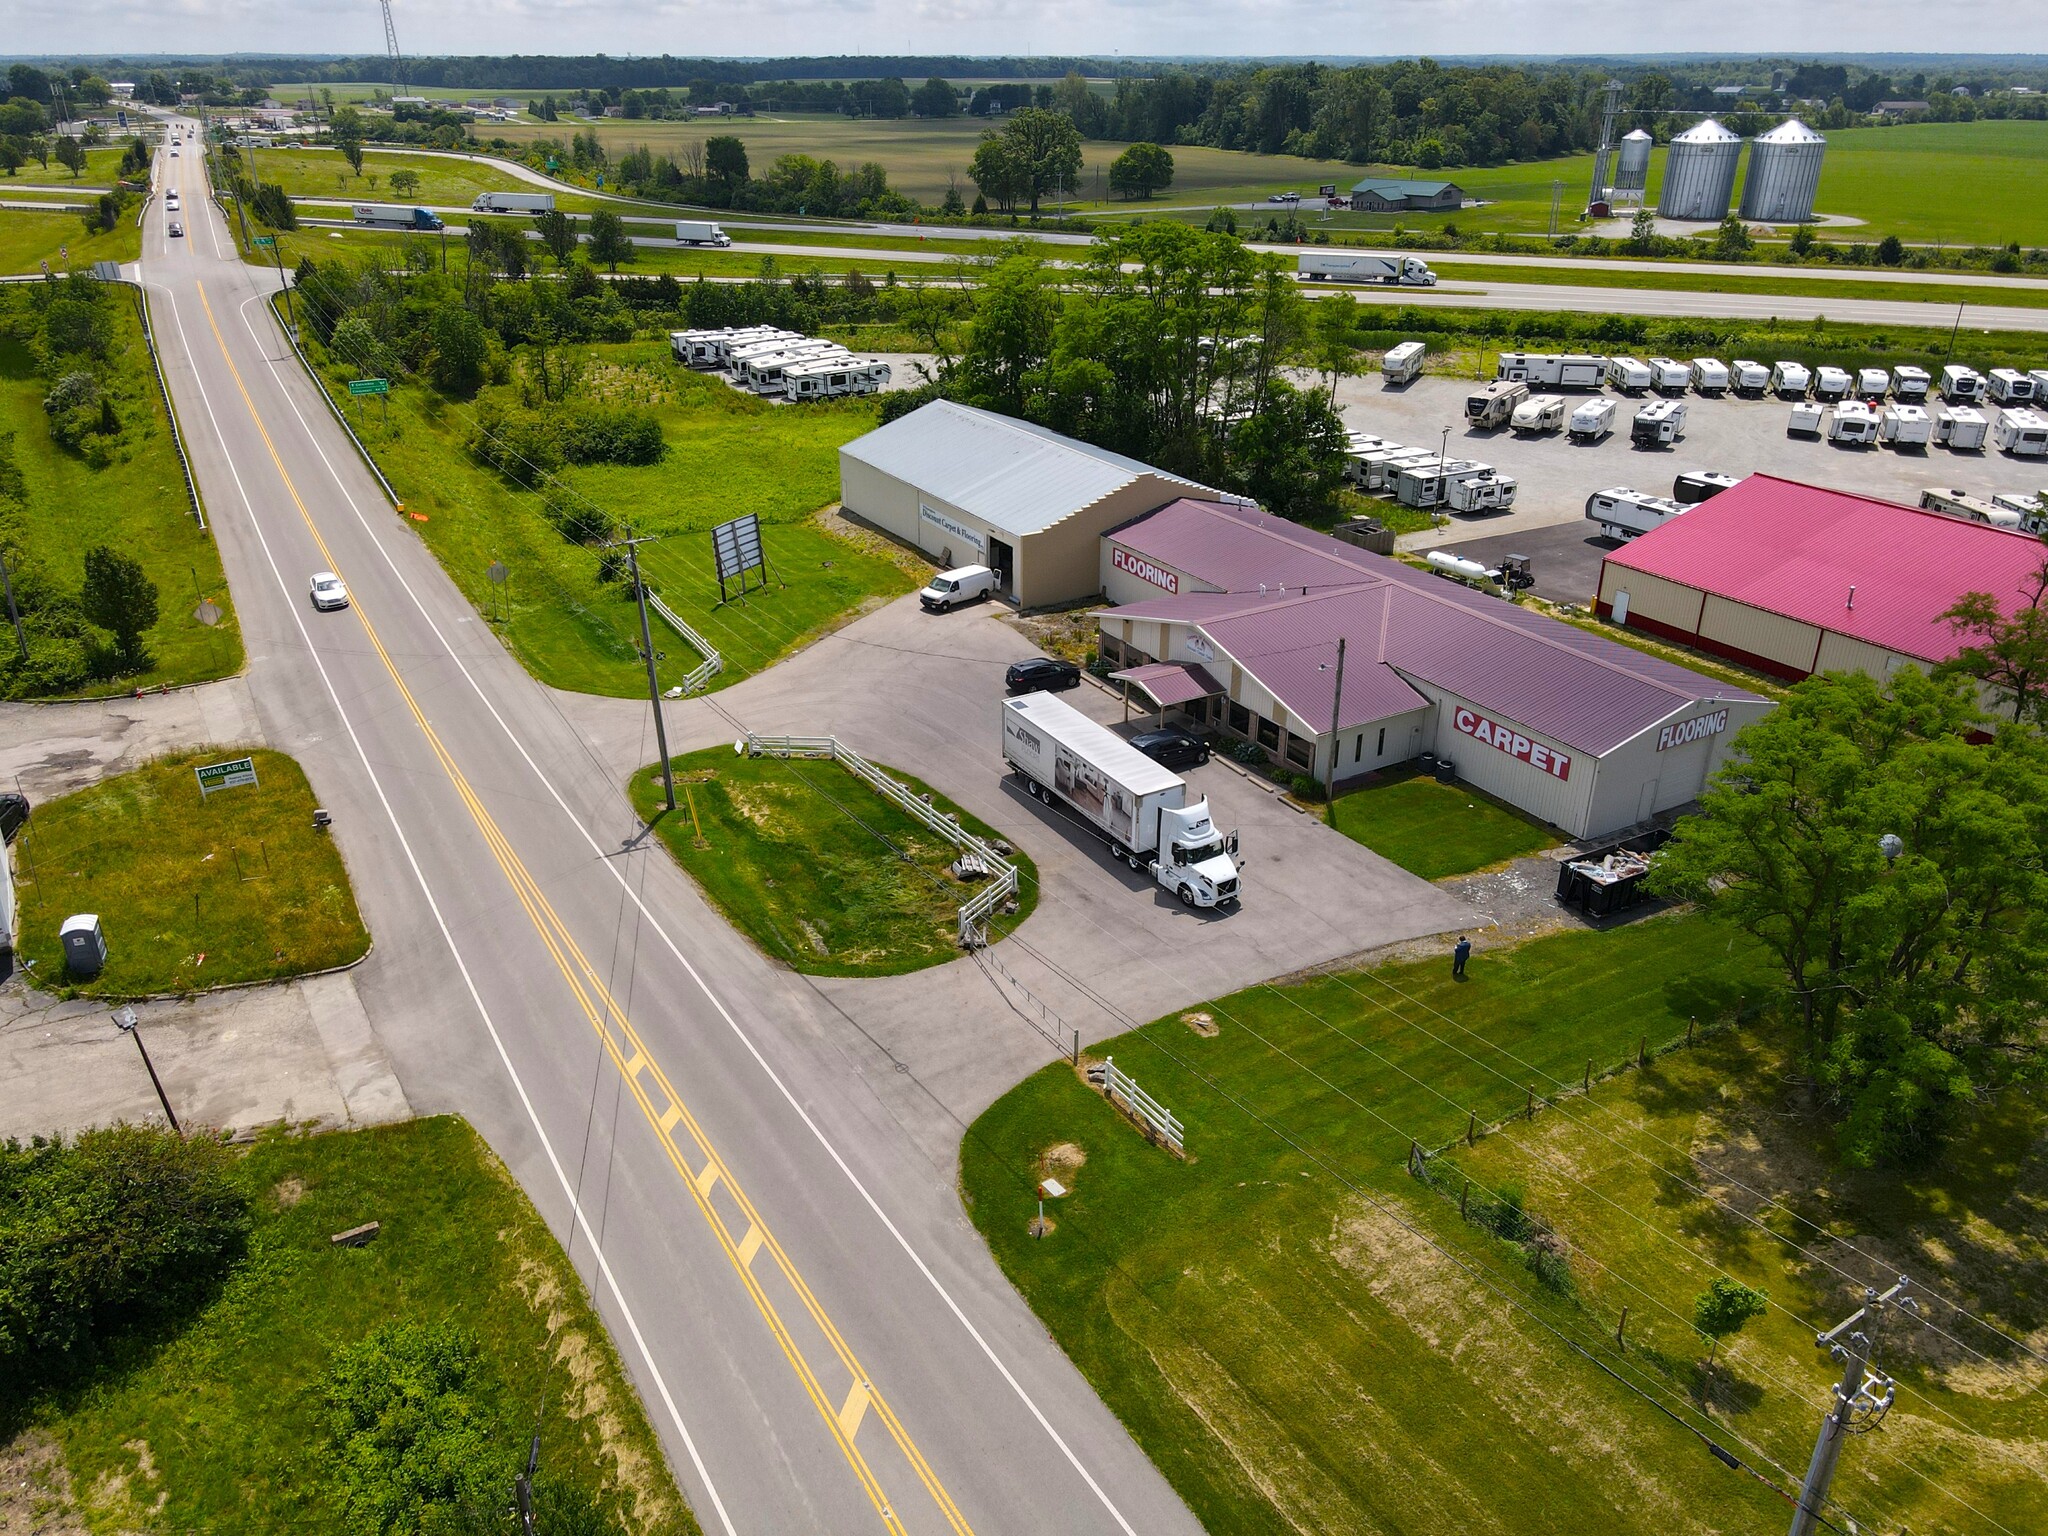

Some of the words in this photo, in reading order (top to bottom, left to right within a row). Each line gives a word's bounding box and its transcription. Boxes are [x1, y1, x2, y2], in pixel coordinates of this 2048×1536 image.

[922, 508, 941, 525] Discount
[942, 519, 956, 533] Carpet
[957, 526, 961, 535] &
[962, 529, 981, 548] Flooring
[1114, 549, 1176, 592] FLOORING
[1019, 729, 1040, 755] Shaw
[1457, 710, 1568, 776] CARPET
[1658, 710, 1727, 751] FLOORING
[200, 762, 251, 778] AVAILABLE
